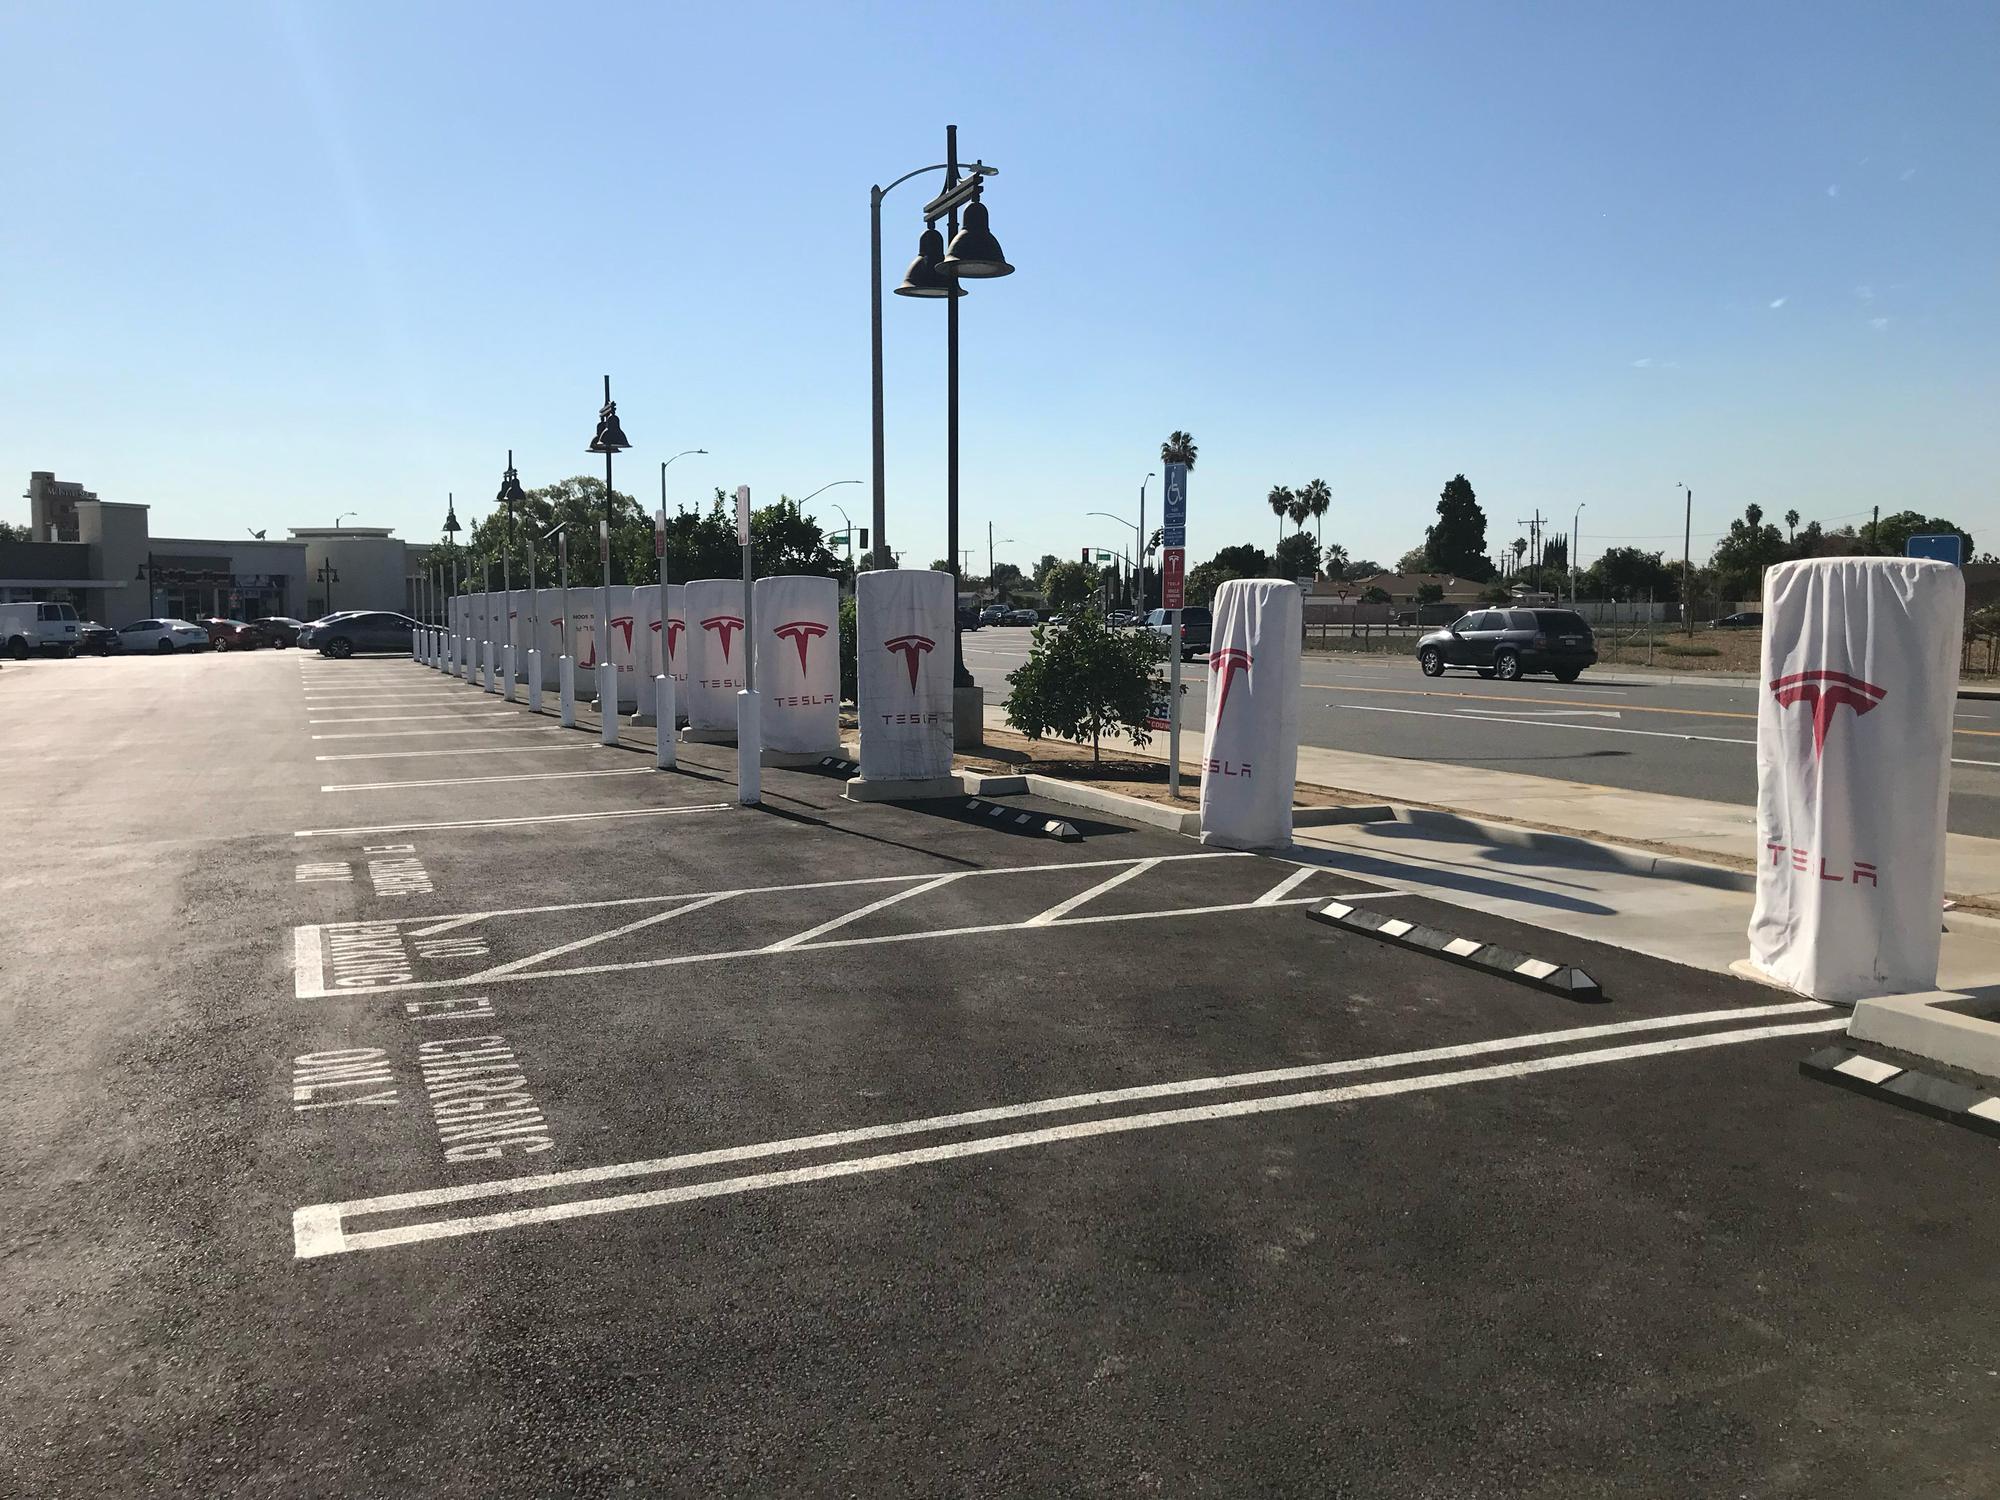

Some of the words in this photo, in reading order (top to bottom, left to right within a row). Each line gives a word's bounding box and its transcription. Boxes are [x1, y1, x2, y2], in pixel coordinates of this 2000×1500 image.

[700, 679, 745, 688] TESL
[774, 694, 834, 707] TESLA
[1766, 843, 1878, 888] TELA
[329, 924, 413, 986] PARKING
[414, 936, 490, 958] NO
[406, 997, 495, 1021] EV
[293, 1047, 398, 1112] ONLY
[418, 1035, 554, 1163] CHARGING
